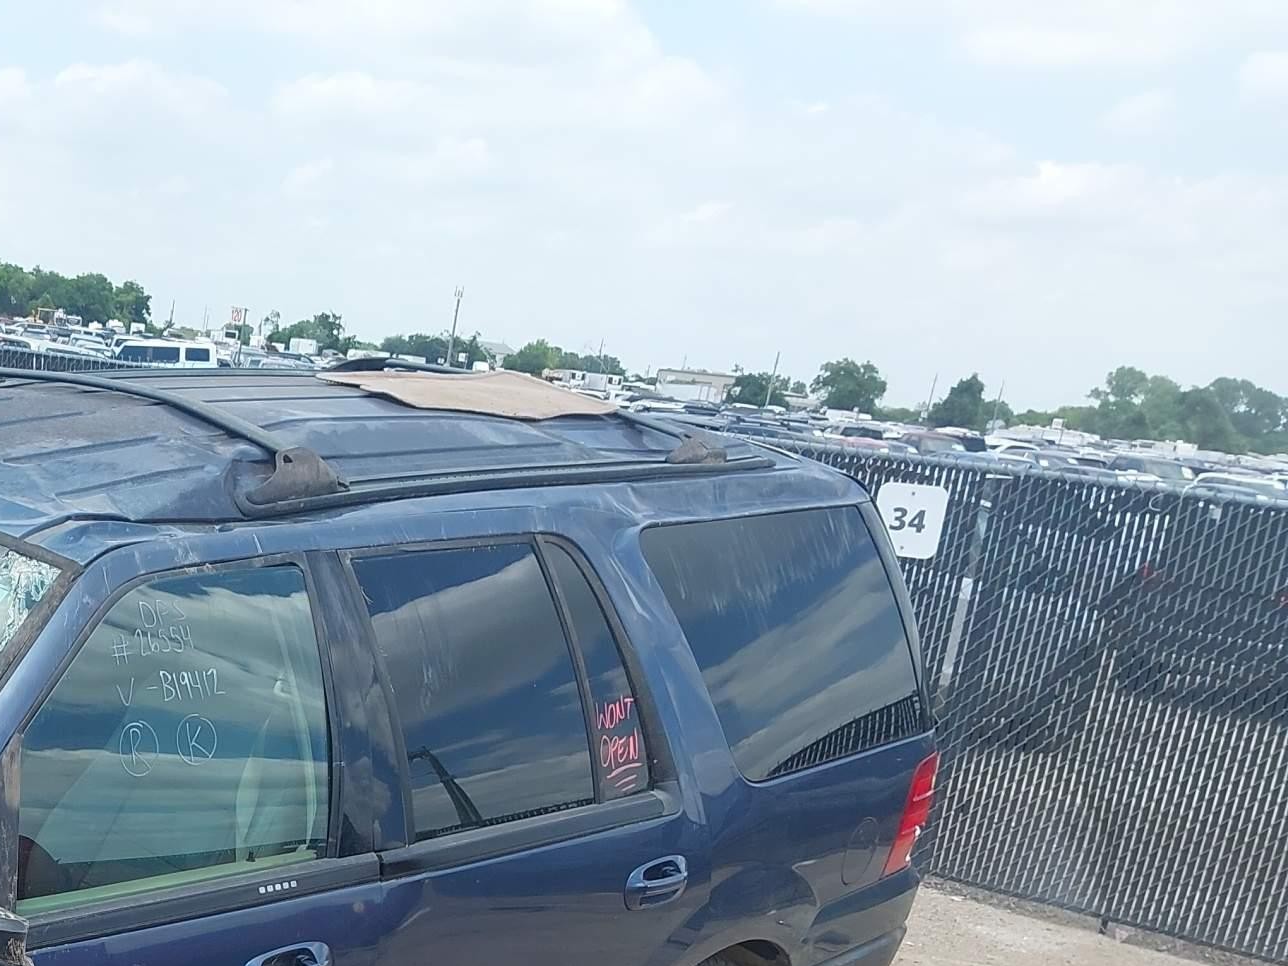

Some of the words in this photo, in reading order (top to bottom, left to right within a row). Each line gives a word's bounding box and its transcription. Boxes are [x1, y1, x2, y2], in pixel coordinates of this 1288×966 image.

[889, 507, 926, 533] 34
[595, 694, 634, 730] WONT
[600, 727, 639, 768] OPEN
